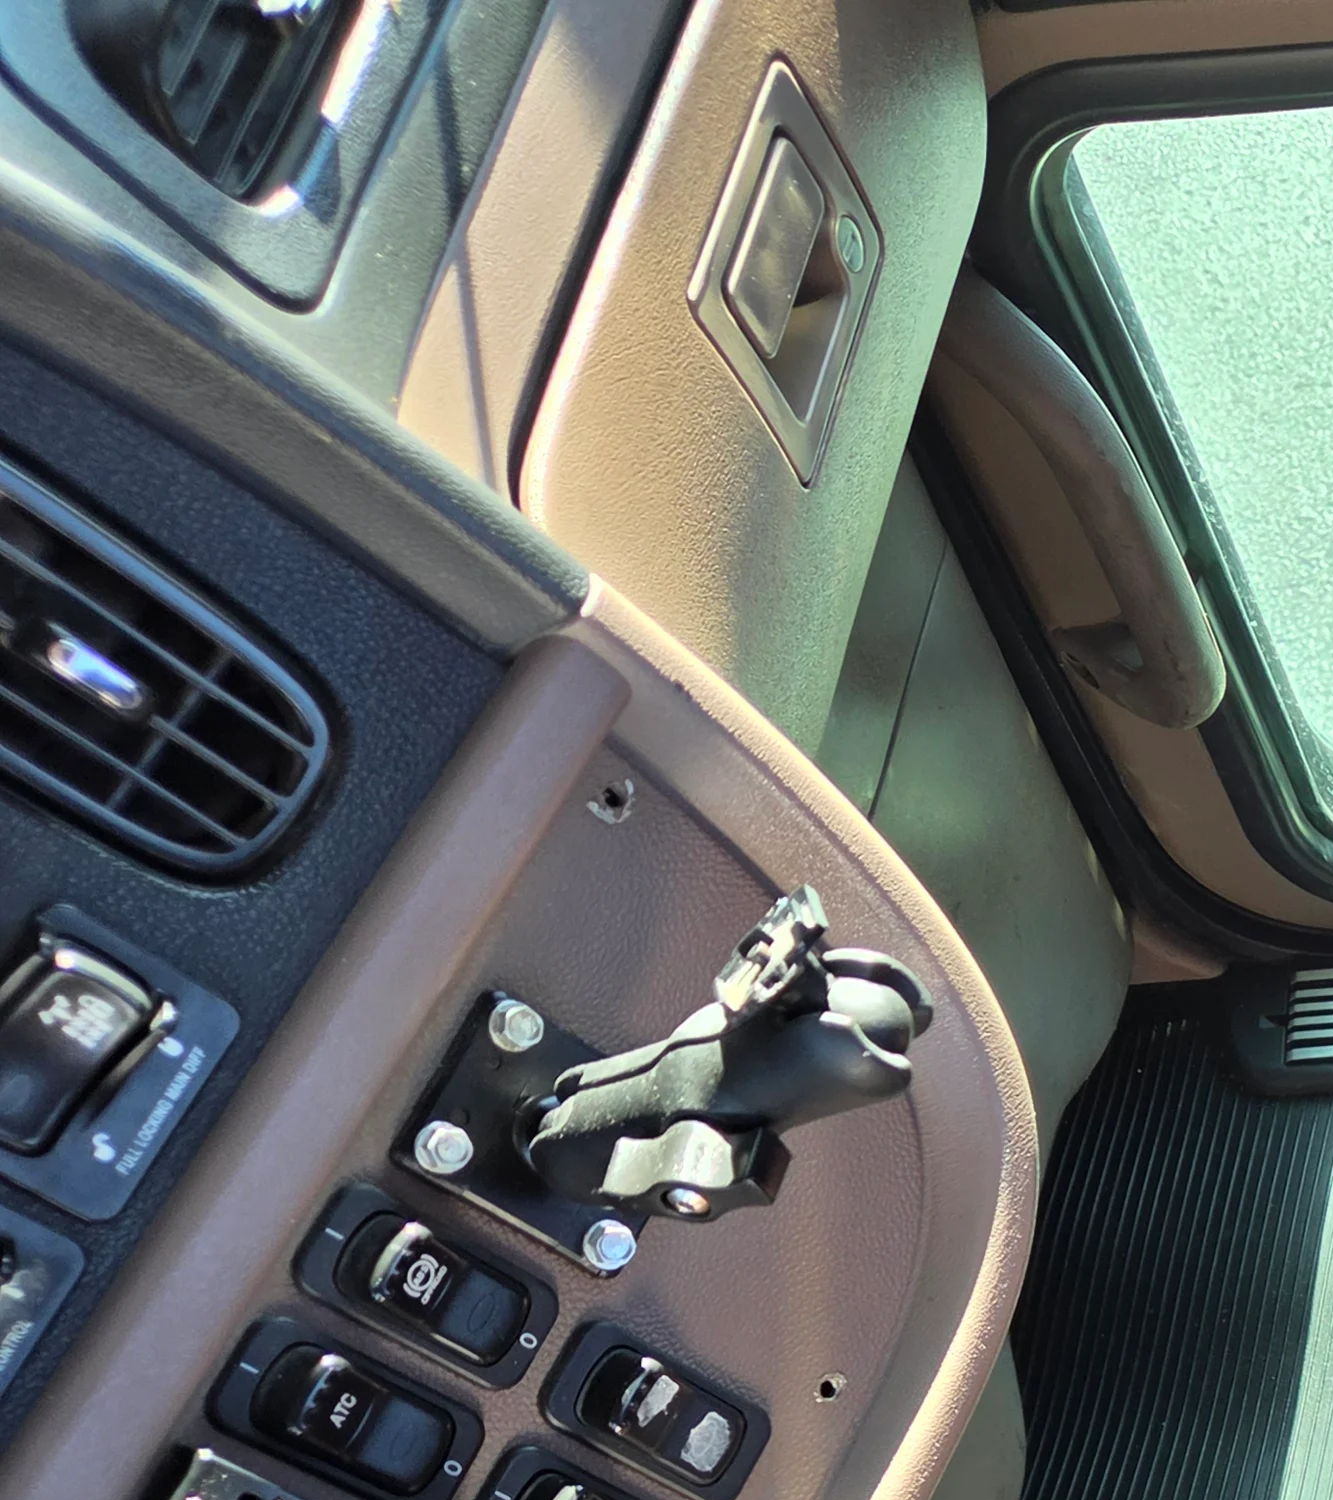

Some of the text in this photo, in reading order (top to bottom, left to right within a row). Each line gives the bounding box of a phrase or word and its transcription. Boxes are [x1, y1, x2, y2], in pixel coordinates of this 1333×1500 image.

[115, 1148, 139, 1175] FULL
[134, 1099, 173, 1147] LOCKING
[164, 1071, 190, 1101] MAIN
[329, 1392, 357, 1429] ATC
